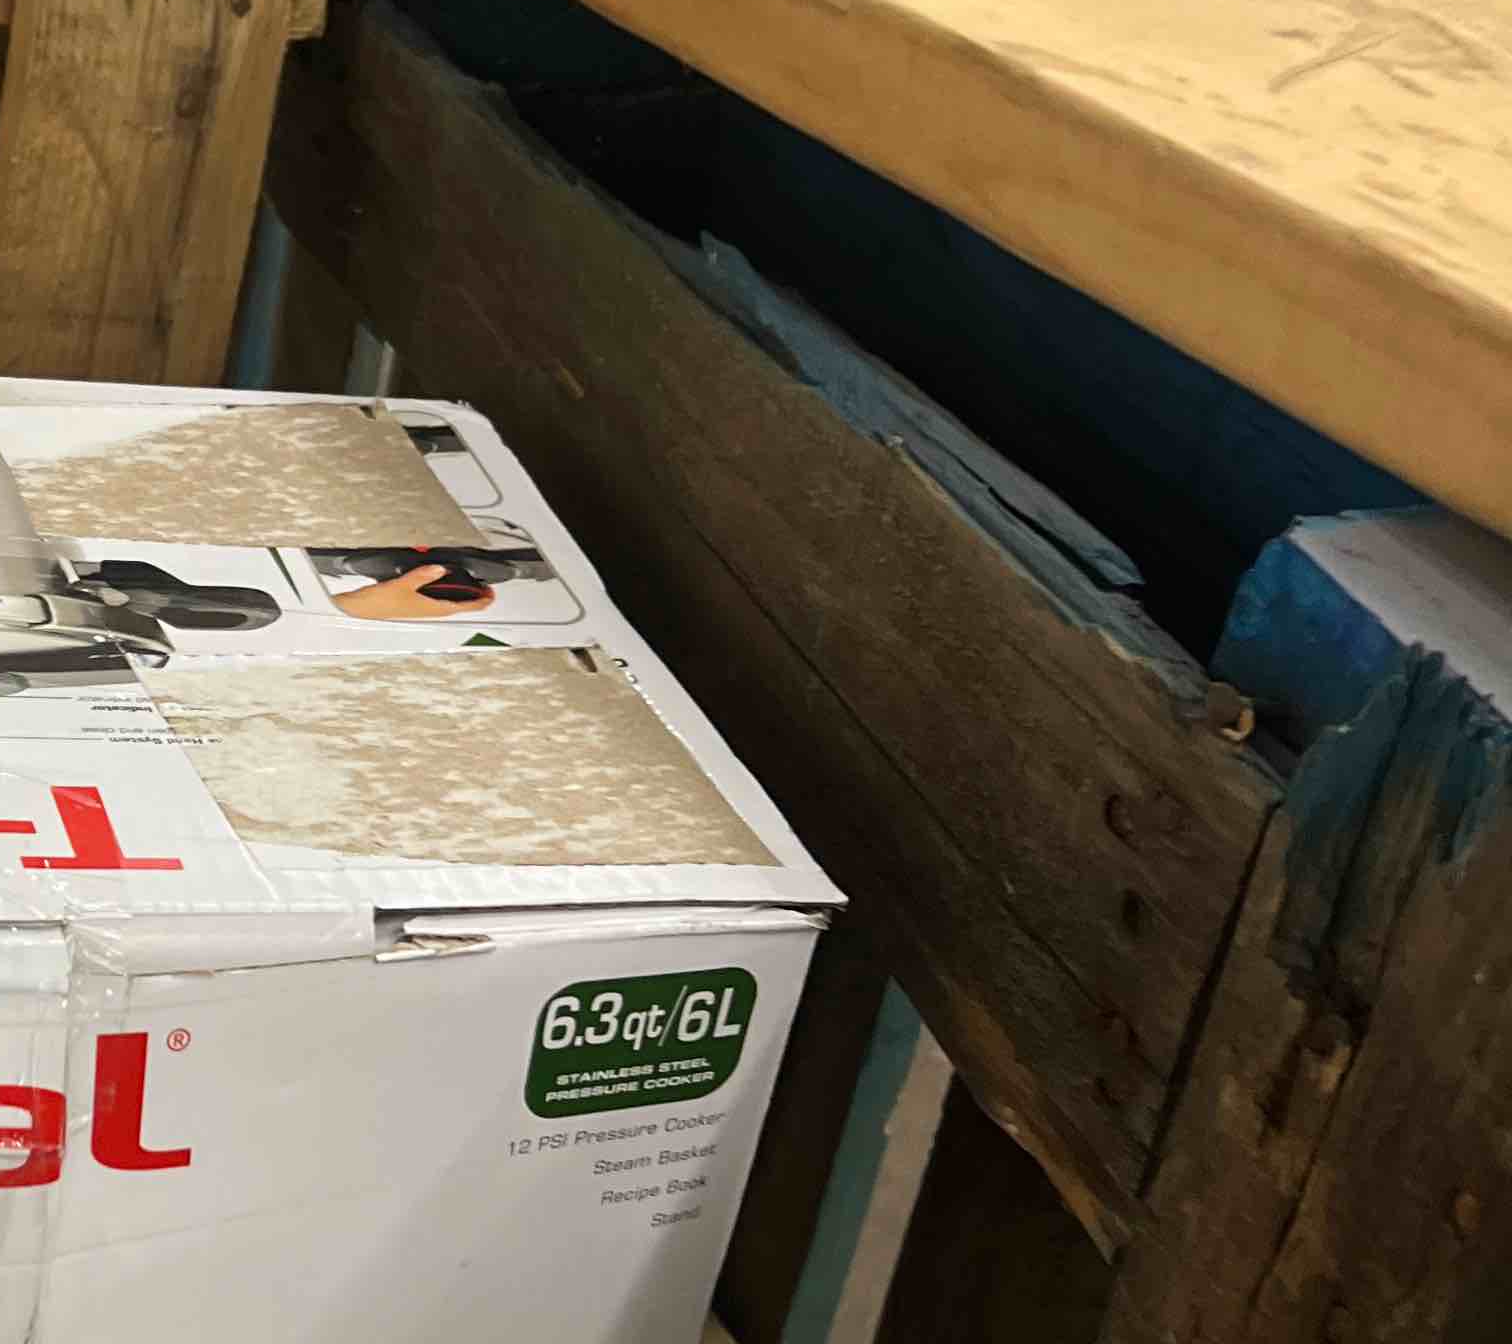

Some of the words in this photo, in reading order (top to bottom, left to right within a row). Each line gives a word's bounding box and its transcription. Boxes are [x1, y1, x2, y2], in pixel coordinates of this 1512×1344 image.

[545, 1081, 639, 1103] PRESSURE
[643, 1071, 716, 1090] COOKER
[555, 1062, 654, 1086] STAINLESS
[658, 1057, 712, 1074] STEEL
[509, 1139, 531, 1156] 12
[538, 1132, 569, 1152] PSI
[574, 1122, 658, 1146] Pressure
[664, 1111, 727, 1133] Cooker
[592, 1155, 653, 1175] Steam
[658, 1142, 720, 1165] Basket
[600, 1184, 660, 1207] Recipe
[666, 1174, 708, 1194] Book
